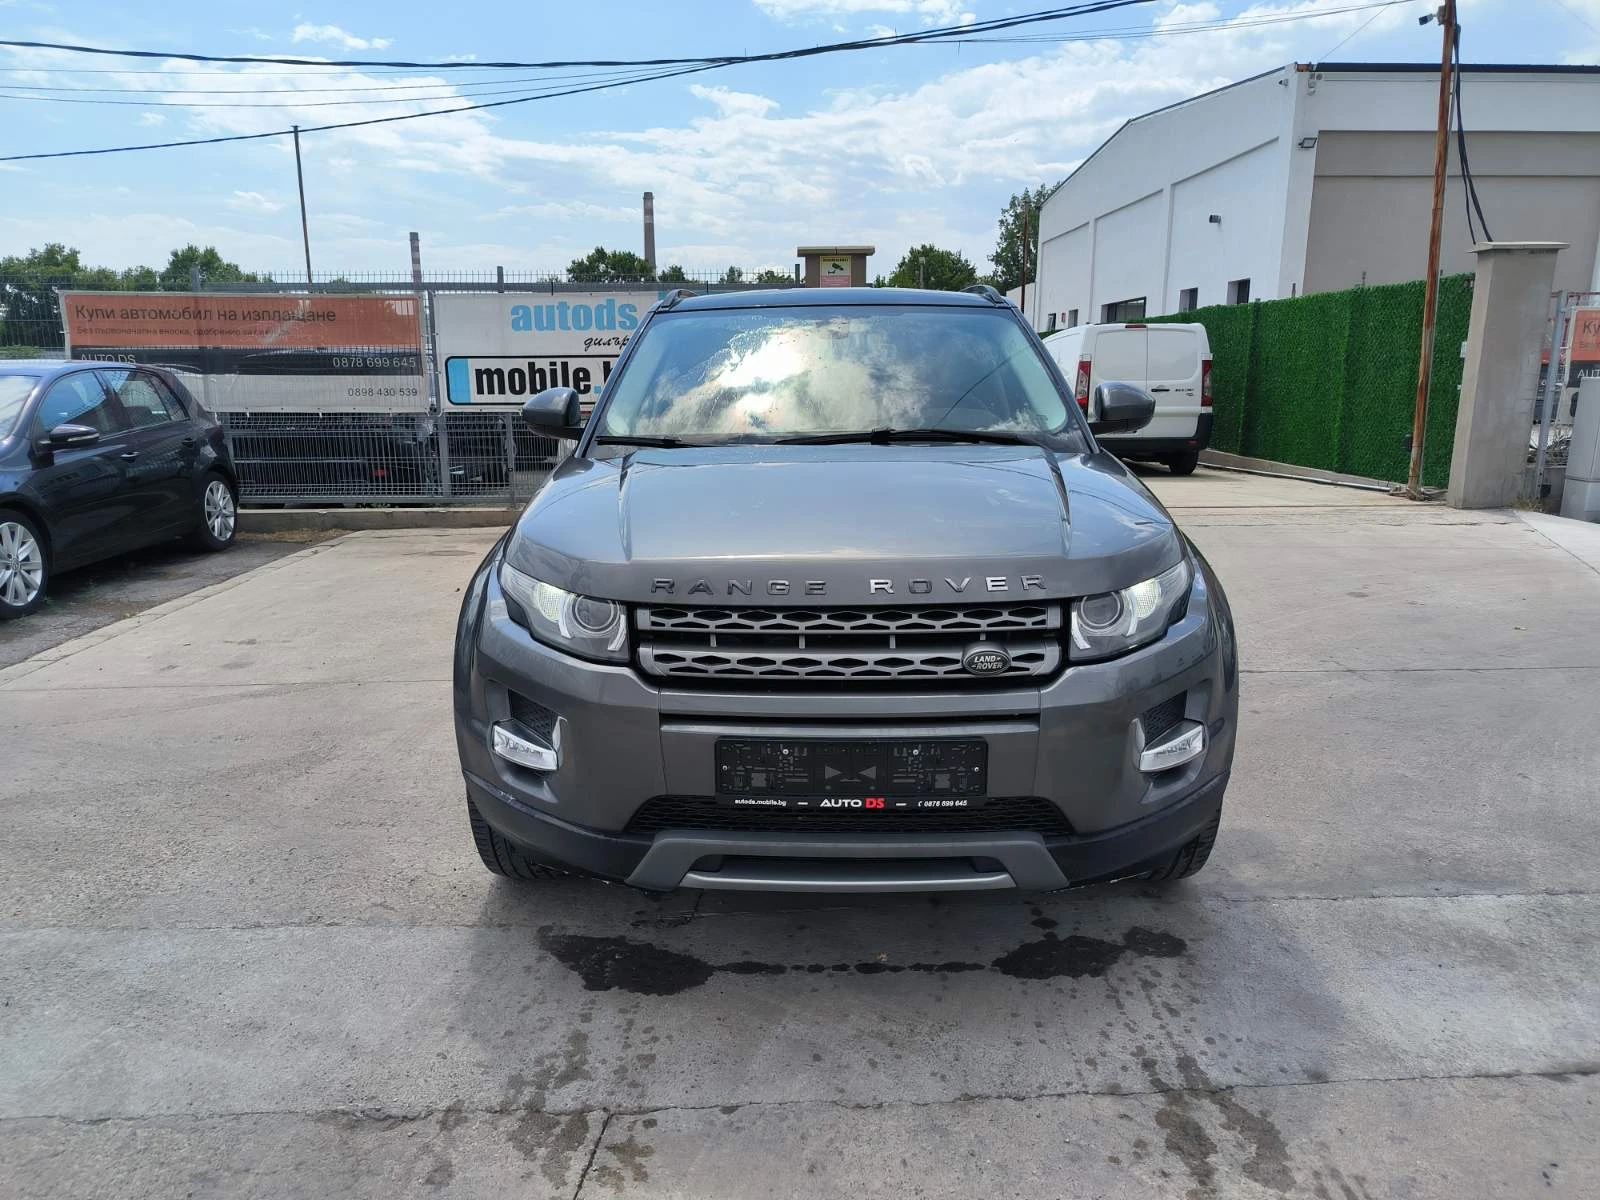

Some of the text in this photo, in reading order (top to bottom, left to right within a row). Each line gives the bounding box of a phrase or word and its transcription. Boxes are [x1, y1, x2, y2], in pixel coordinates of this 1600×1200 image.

[75, 305, 336, 323] Купи автомобил на изплащане
[510, 299, 639, 331] autods
[118, 354, 136, 364] DS
[332, 358, 416, 368] 0878 699 645
[348, 388, 374, 396] 0898
[377, 388, 396, 396] 430
[651, 574, 1048, 596] RANGE ROVER
[976, 662, 1003, 670] ROVER
[820, 799, 862, 808] AUTO
[865, 798, 885, 809] DS
